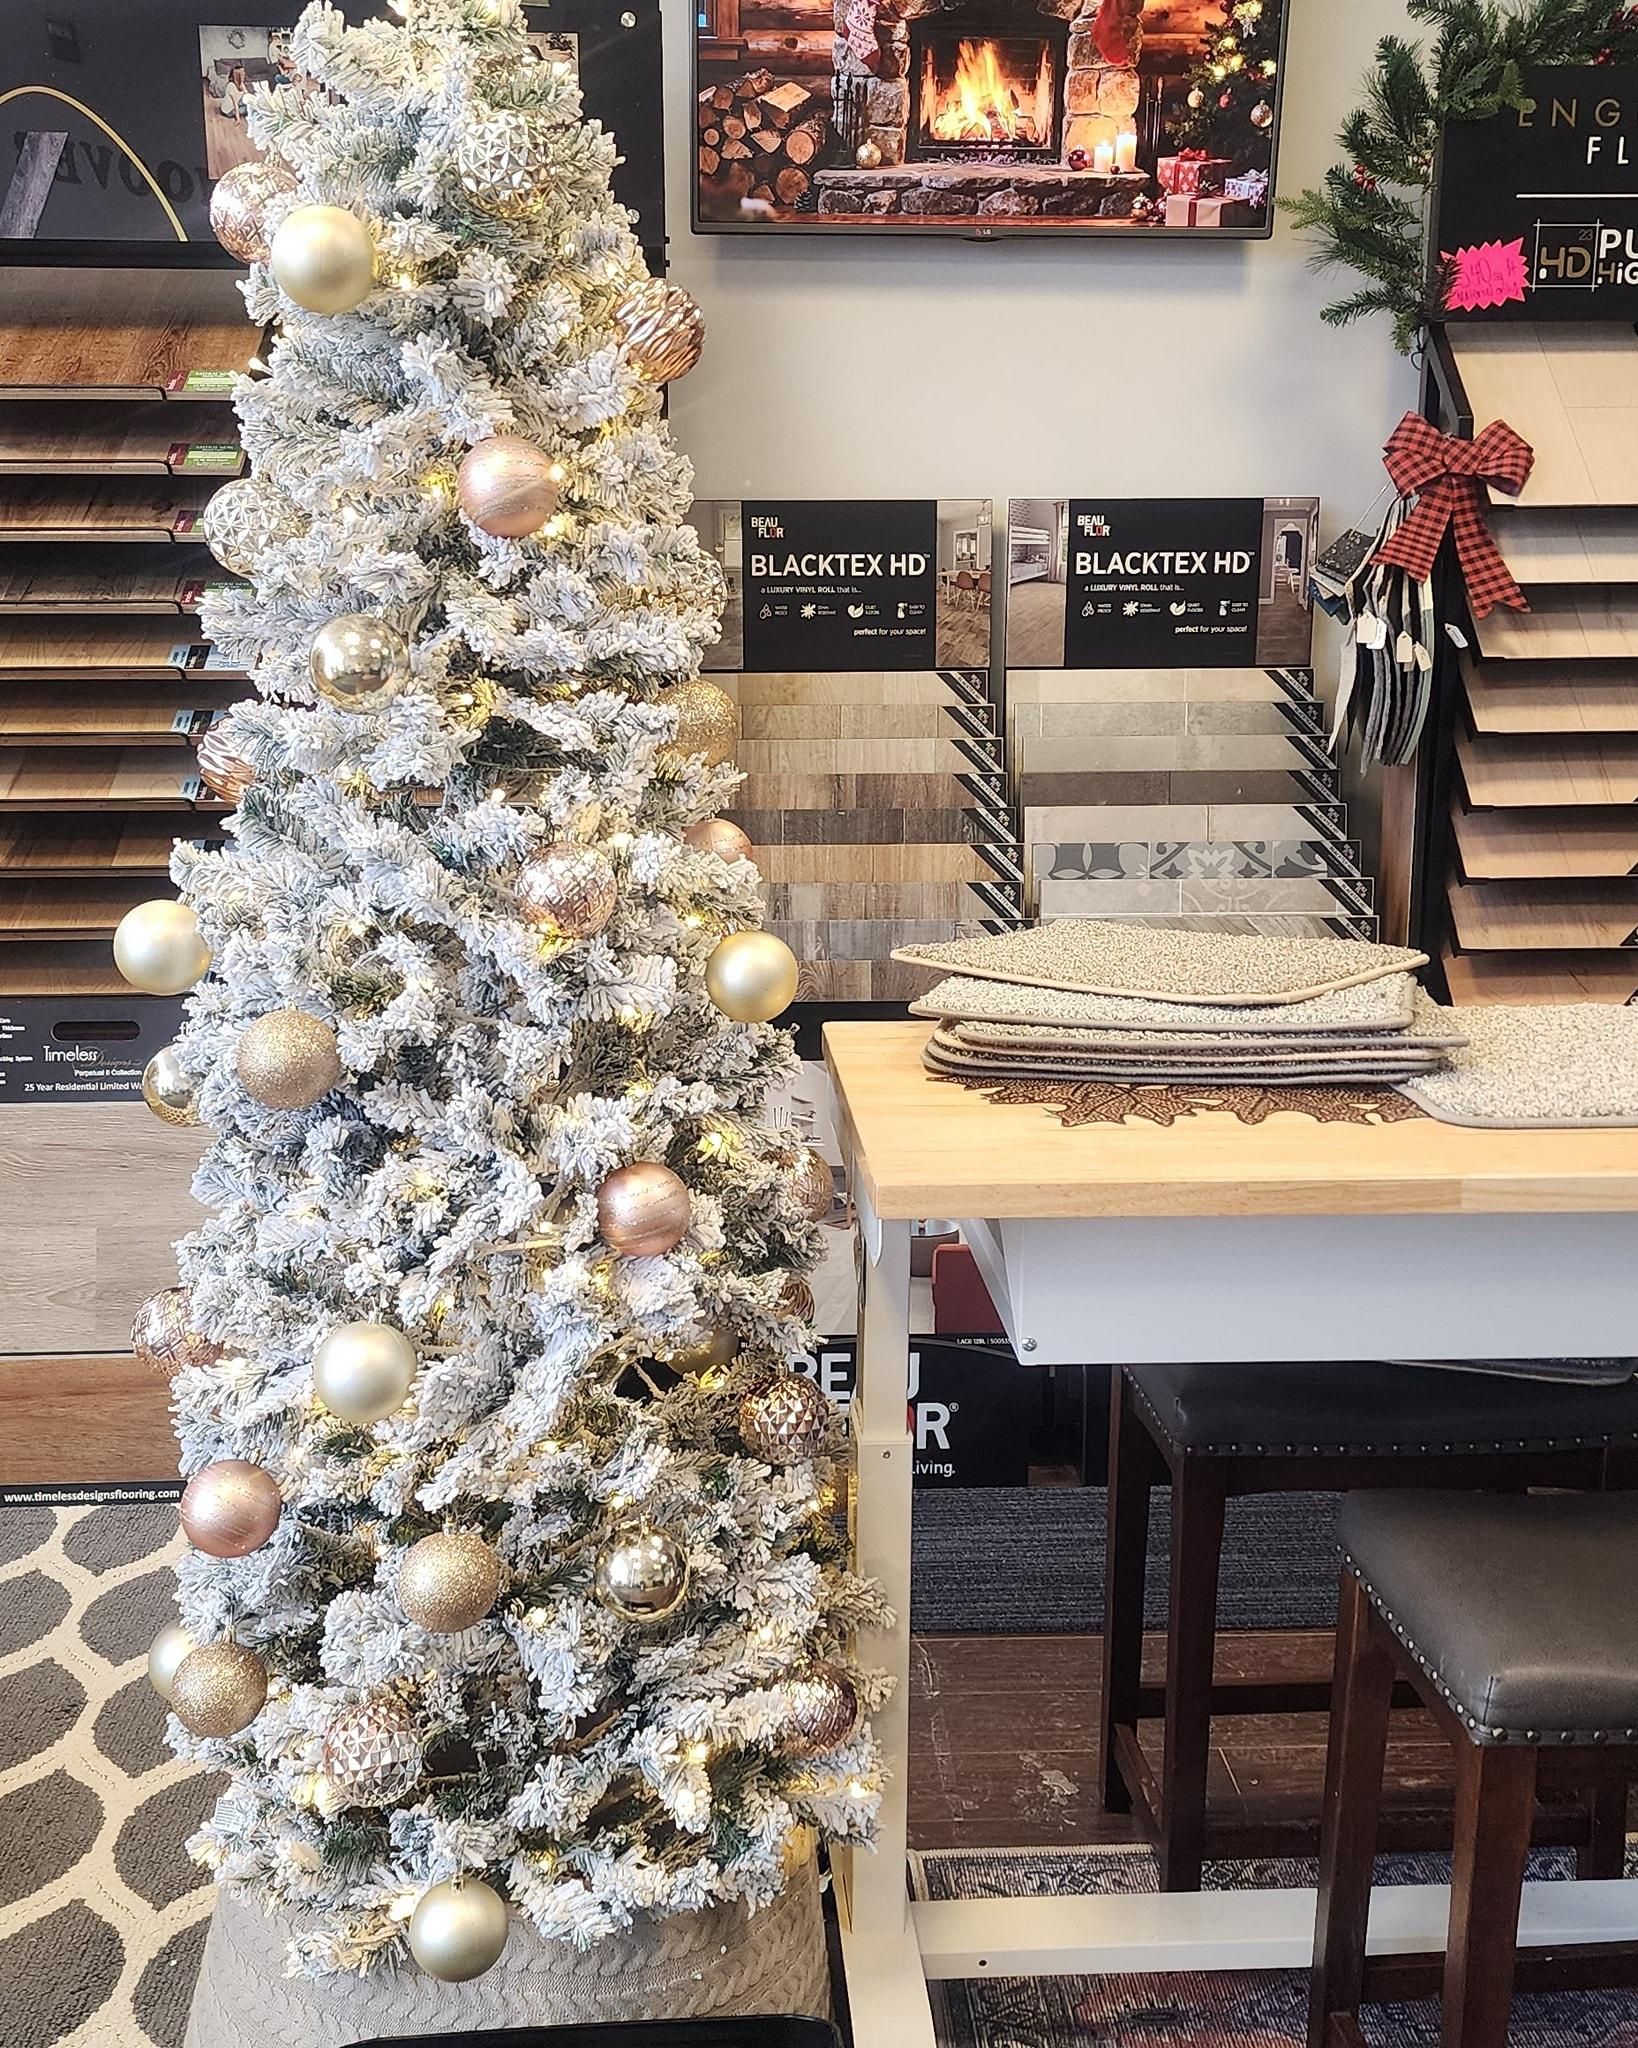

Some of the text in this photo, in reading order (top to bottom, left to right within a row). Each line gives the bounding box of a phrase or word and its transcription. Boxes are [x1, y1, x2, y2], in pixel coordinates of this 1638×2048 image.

[751, 517, 778, 528] BEAU
[1077, 515, 1104, 526] BEAU
[758, 528, 785, 539] FLOR
[1084, 526, 1111, 537] FLOR
[751, 554, 883, 577] BLACKTEX
[1075, 552, 1208, 575] BLACKTEX
[767, 586, 794, 594] LUXURY
[795, 586, 816, 594] VINYL
[818, 586, 836, 594] ROLL
[836, 586, 850, 594] that
[1090, 584, 1118, 592] LUXURY
[1118, 584, 1139, 592] VINYL
[1140, 584, 1159, 592] ROLL
[1160, 584, 1174, 592] that
[853, 627, 878, 637] perfect
[878, 628, 888, 636] for
[889, 629, 904, 637] your
[1174, 625, 1199, 634] perfect
[1210, 627, 1225, 635] your
[43, 1045, 98, 1062] Timeless
[111, 1068, 143, 1076] Collection
[24, 1083, 35, 1092] 25
[36, 1083, 54, 1092] Year
[55, 1082, 99, 1092] Residential
[100, 1081, 129, 1091] Limited
[912, 1459, 956, 1478] iving.
[4, 1488, 180, 1503] www.timelessdesignsflooring.com
